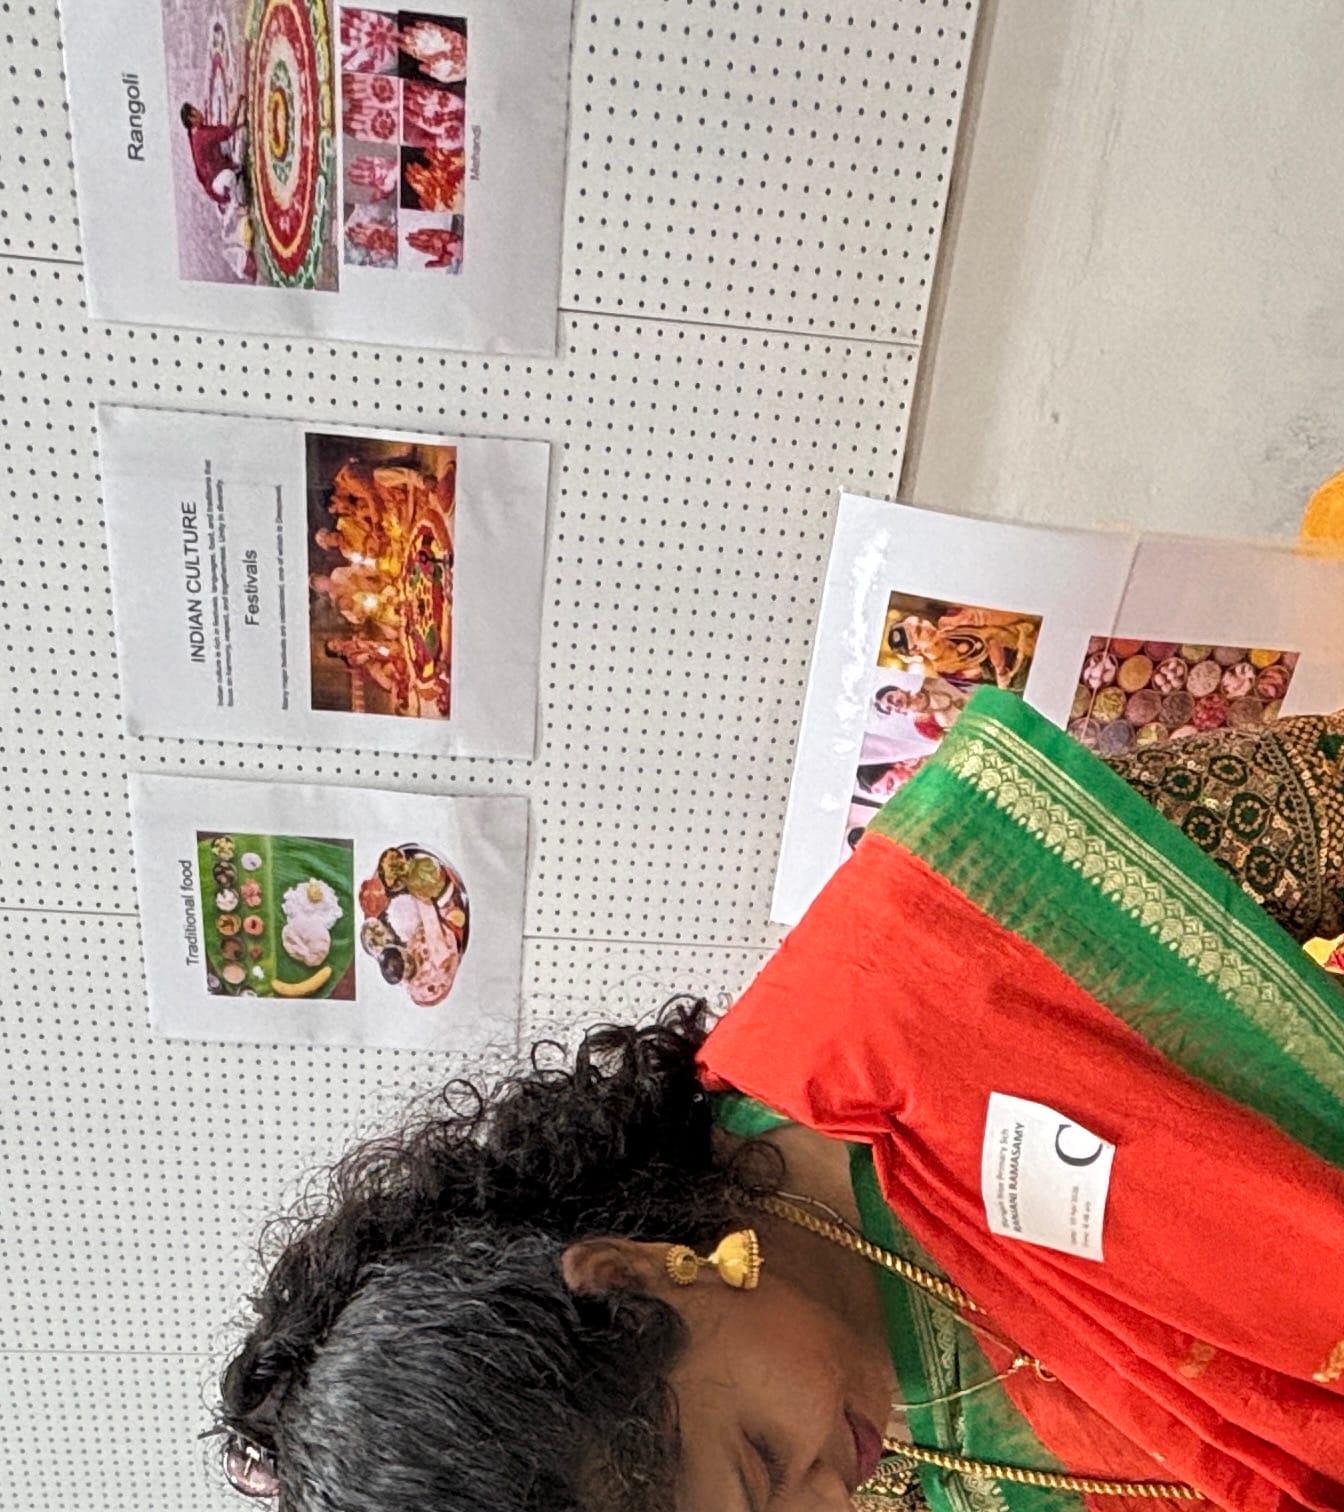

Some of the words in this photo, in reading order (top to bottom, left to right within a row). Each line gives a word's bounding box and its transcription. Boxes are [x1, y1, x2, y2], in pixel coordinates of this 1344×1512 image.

[121, 72, 145, 161] Rangoli
[181, 501, 201, 594] CULTURE
[242, 549, 260, 625] Festivals
[187, 599, 205, 663] INDIAN
[179, 859, 194, 891] food
[181, 895, 199, 966] Traditional
[996, 1147, 1008, 1181] Primary
[999, 1128, 1009, 1144] Sch
[1007, 1122, 1024, 1190] RAMASAMY
